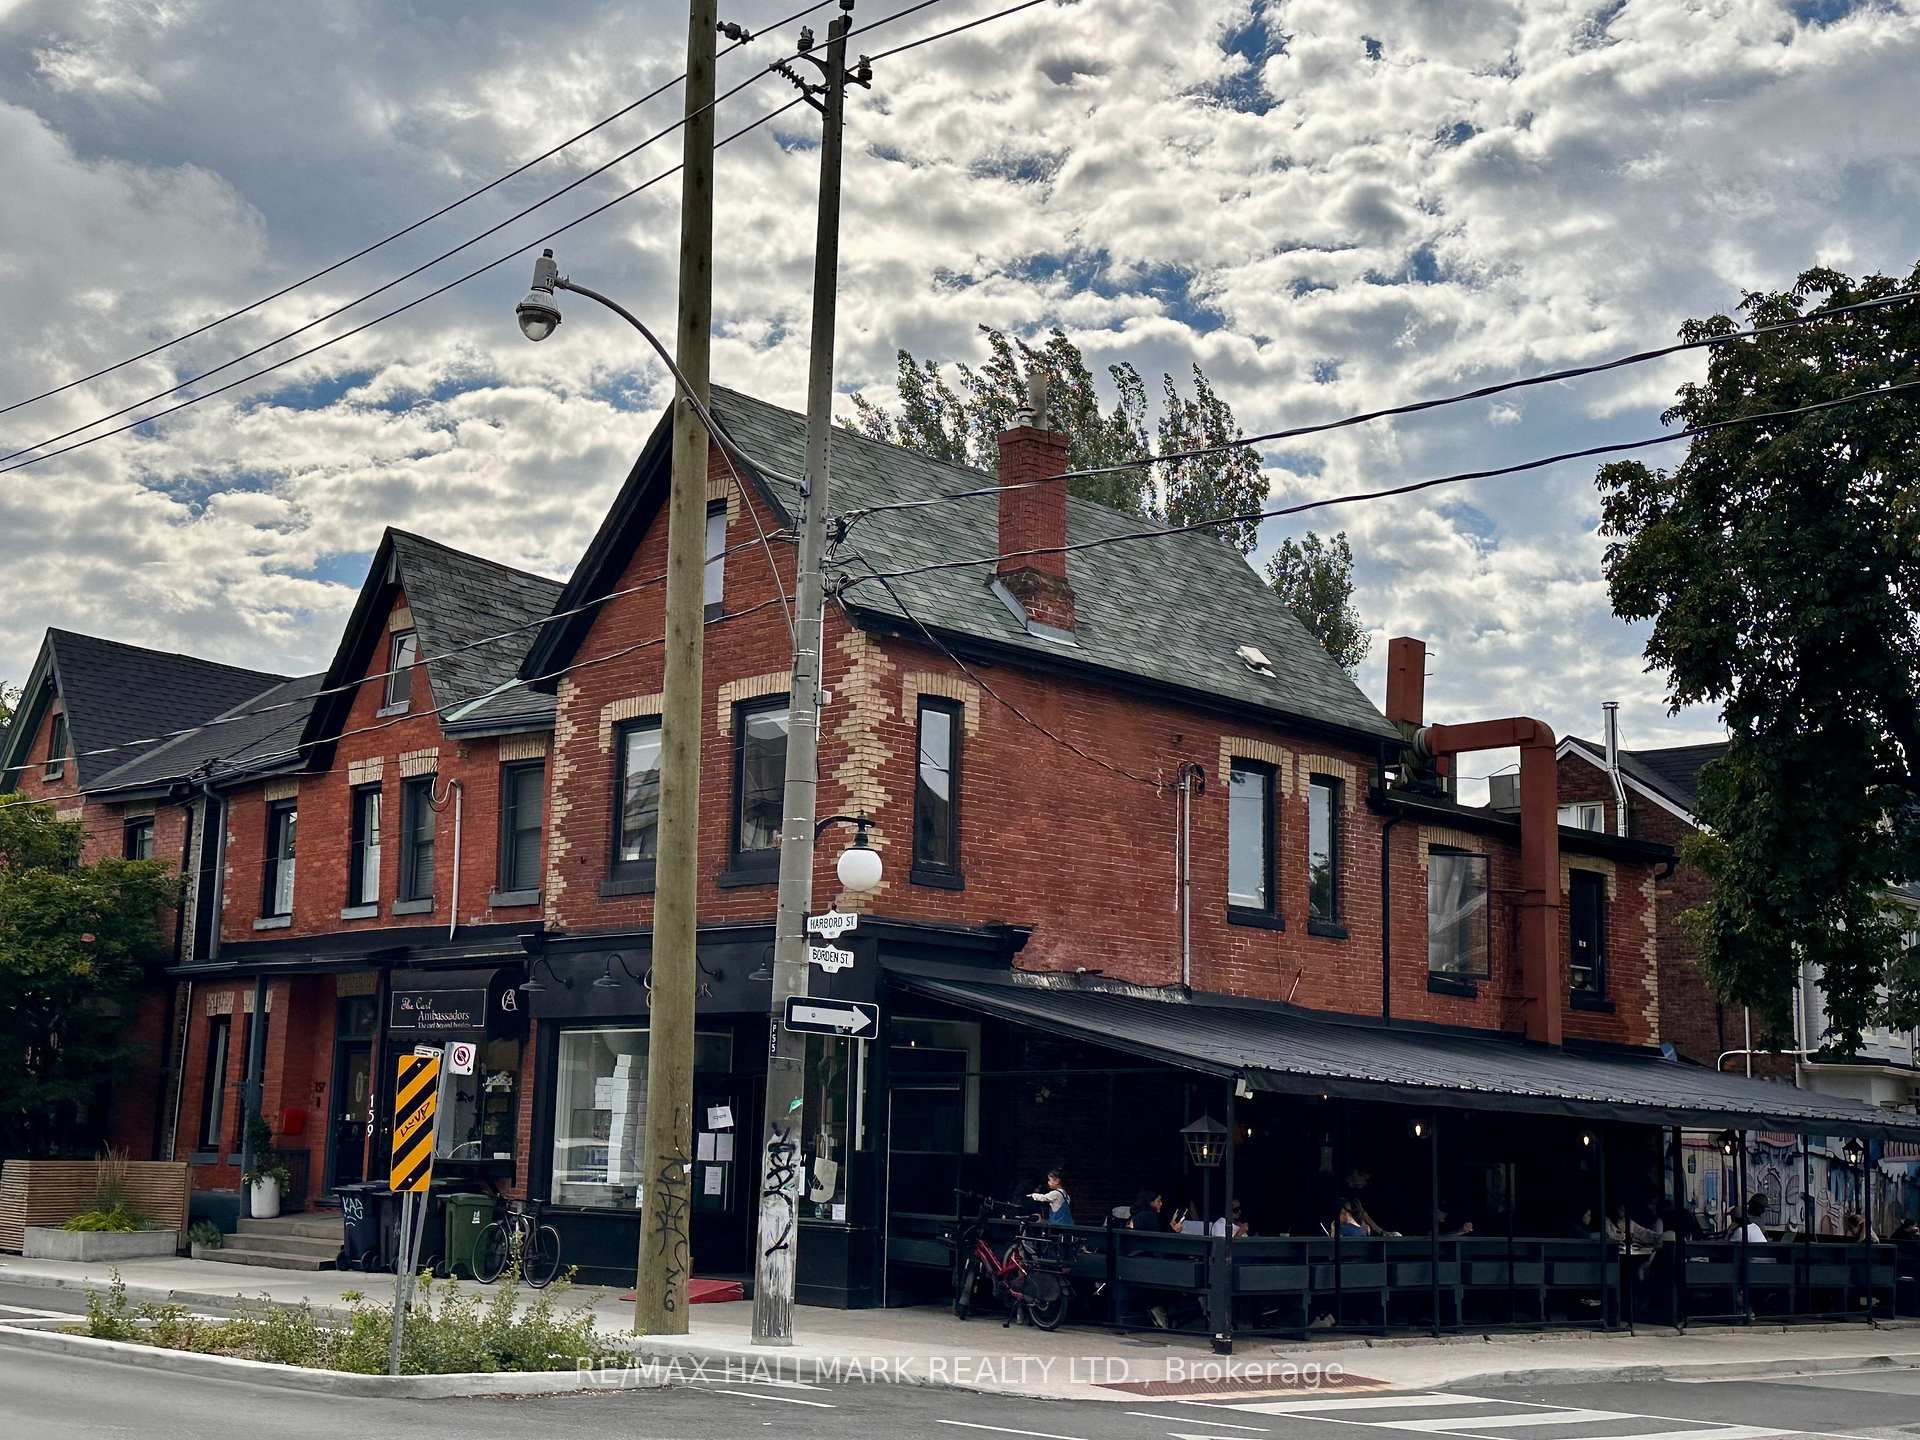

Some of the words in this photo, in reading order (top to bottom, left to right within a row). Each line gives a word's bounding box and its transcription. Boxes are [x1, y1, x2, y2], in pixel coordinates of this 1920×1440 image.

[810, 917, 842, 929] HARBORD
[846, 916, 855, 926] ST
[812, 949, 839, 963] BORDEN
[840, 953, 849, 964] ST
[417, 1009, 470, 1021] Ambassadors
[367, 1093, 375, 1138] 159
